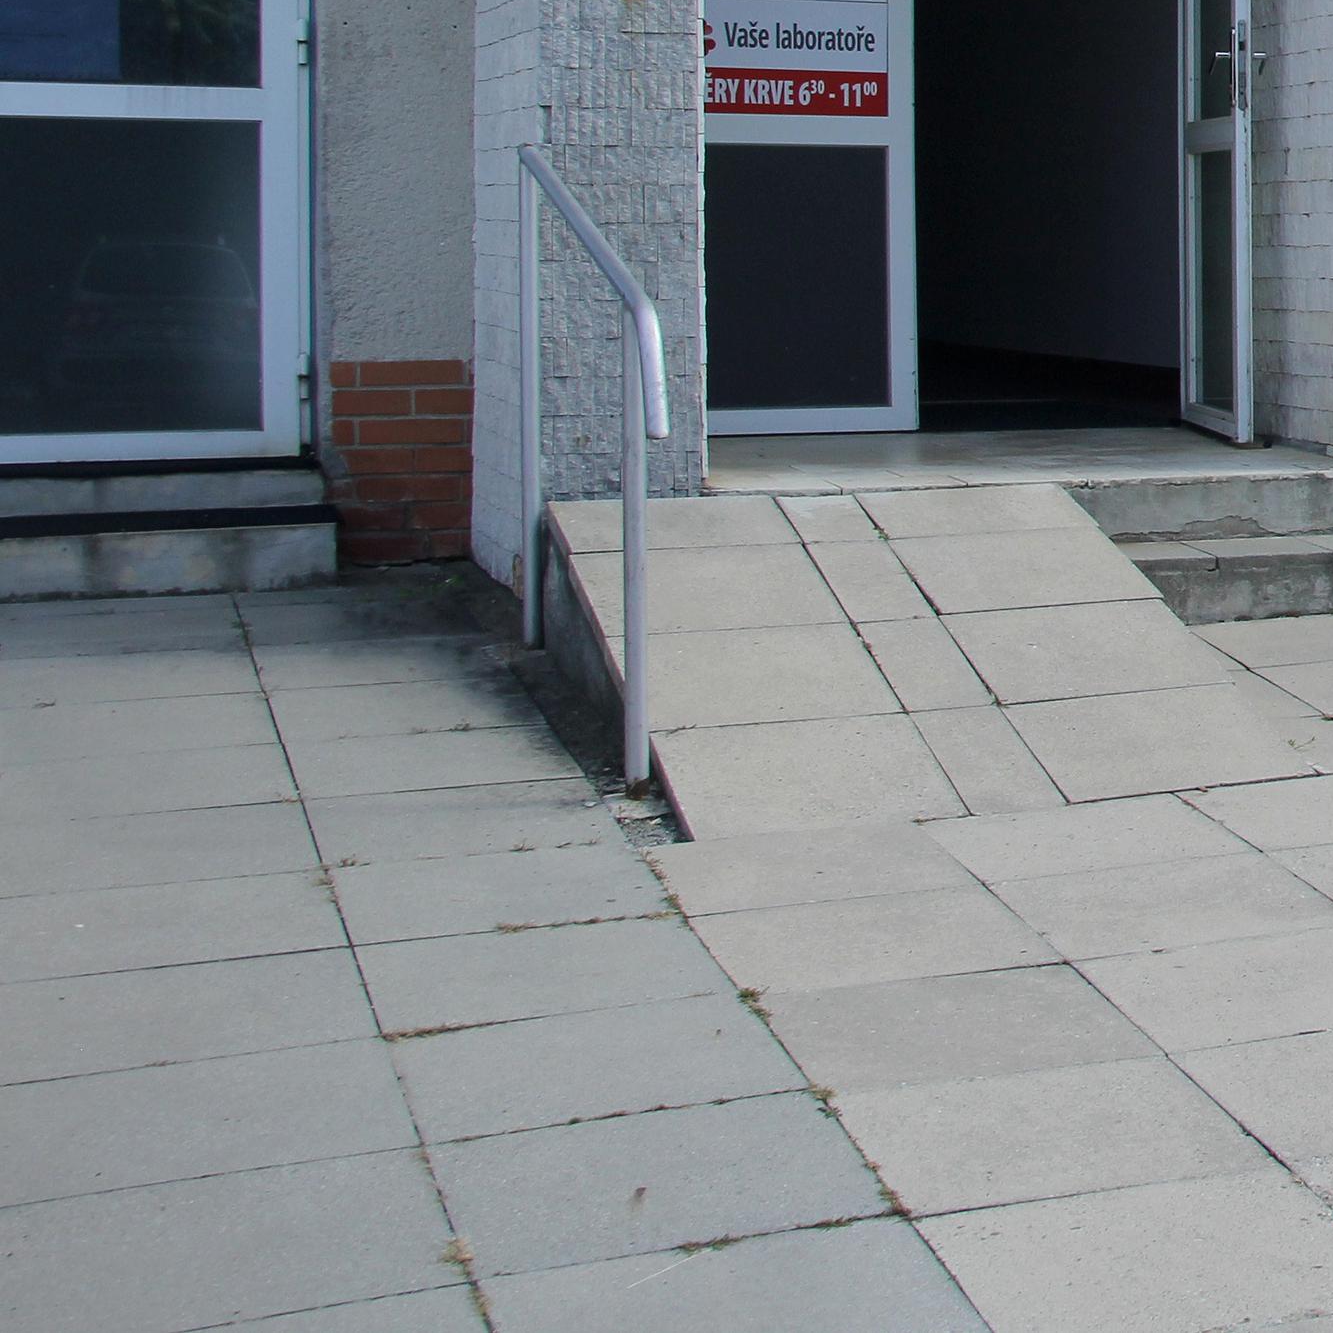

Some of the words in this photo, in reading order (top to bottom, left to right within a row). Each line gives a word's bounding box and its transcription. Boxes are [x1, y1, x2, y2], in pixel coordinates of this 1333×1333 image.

[724, 21, 769, 48] Vaše
[776, 23, 875, 52] laboratoře
[744, 79, 794, 105] KRVE
